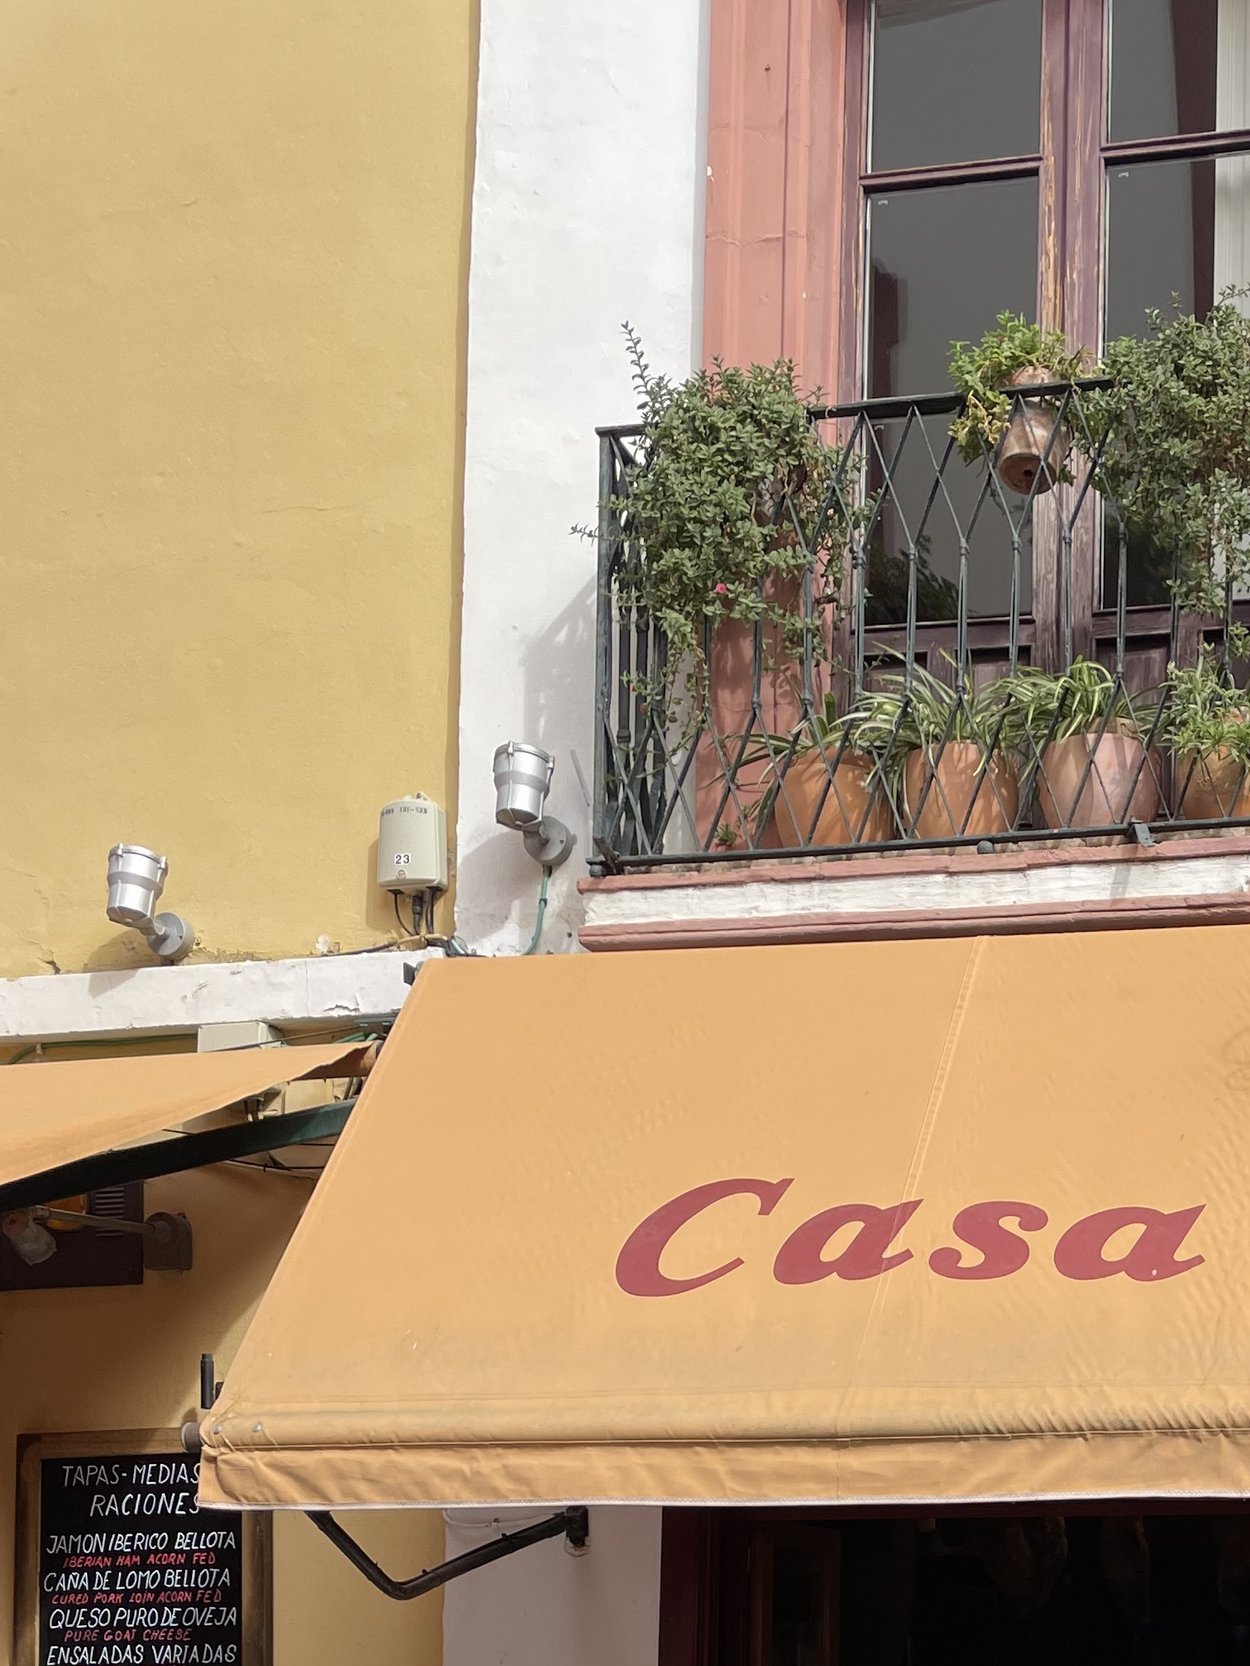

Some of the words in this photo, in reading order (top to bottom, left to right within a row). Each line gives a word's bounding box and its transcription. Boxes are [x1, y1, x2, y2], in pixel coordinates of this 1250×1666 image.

[395, 854, 410, 865] 23
[615, 1178, 1207, 1298] Casa
[90, 1493, 199, 1517] RACIONES
[46, 1533, 106, 1553] JAMON
[109, 1532, 168, 1551] IBERICO
[174, 1532, 236, 1549] BELLOTA
[63, 1556, 111, 1568] IBERIAN
[116, 1555, 140, 1565] HAM
[147, 1554, 186, 1564] ACORN
[192, 1553, 216, 1564] FED
[43, 1572, 89, 1591] CAÑA
[93, 1571, 111, 1590] DE
[116, 1571, 161, 1589] LOMO
[164, 1569, 231, 1588] BELLOTA
[52, 1594, 89, 1604] CURED
[94, 1593, 123, 1603] PORK
[158, 1591, 192, 1602] ACORN
[196, 1589, 222, 1602] FED
[49, 1609, 112, 1629] QUESO
[114, 1608, 159, 1627] PURO
[162, 1608, 182, 1625] DE
[182, 1607, 237, 1626] OVEJA
[64, 1630, 98, 1641] PURE
[103, 1629, 137, 1641] GOAT
[143, 1629, 192, 1640] CHEESE
[47, 1645, 144, 1665] ENSALADAS
[152, 1644, 237, 1663] VARIADAS
